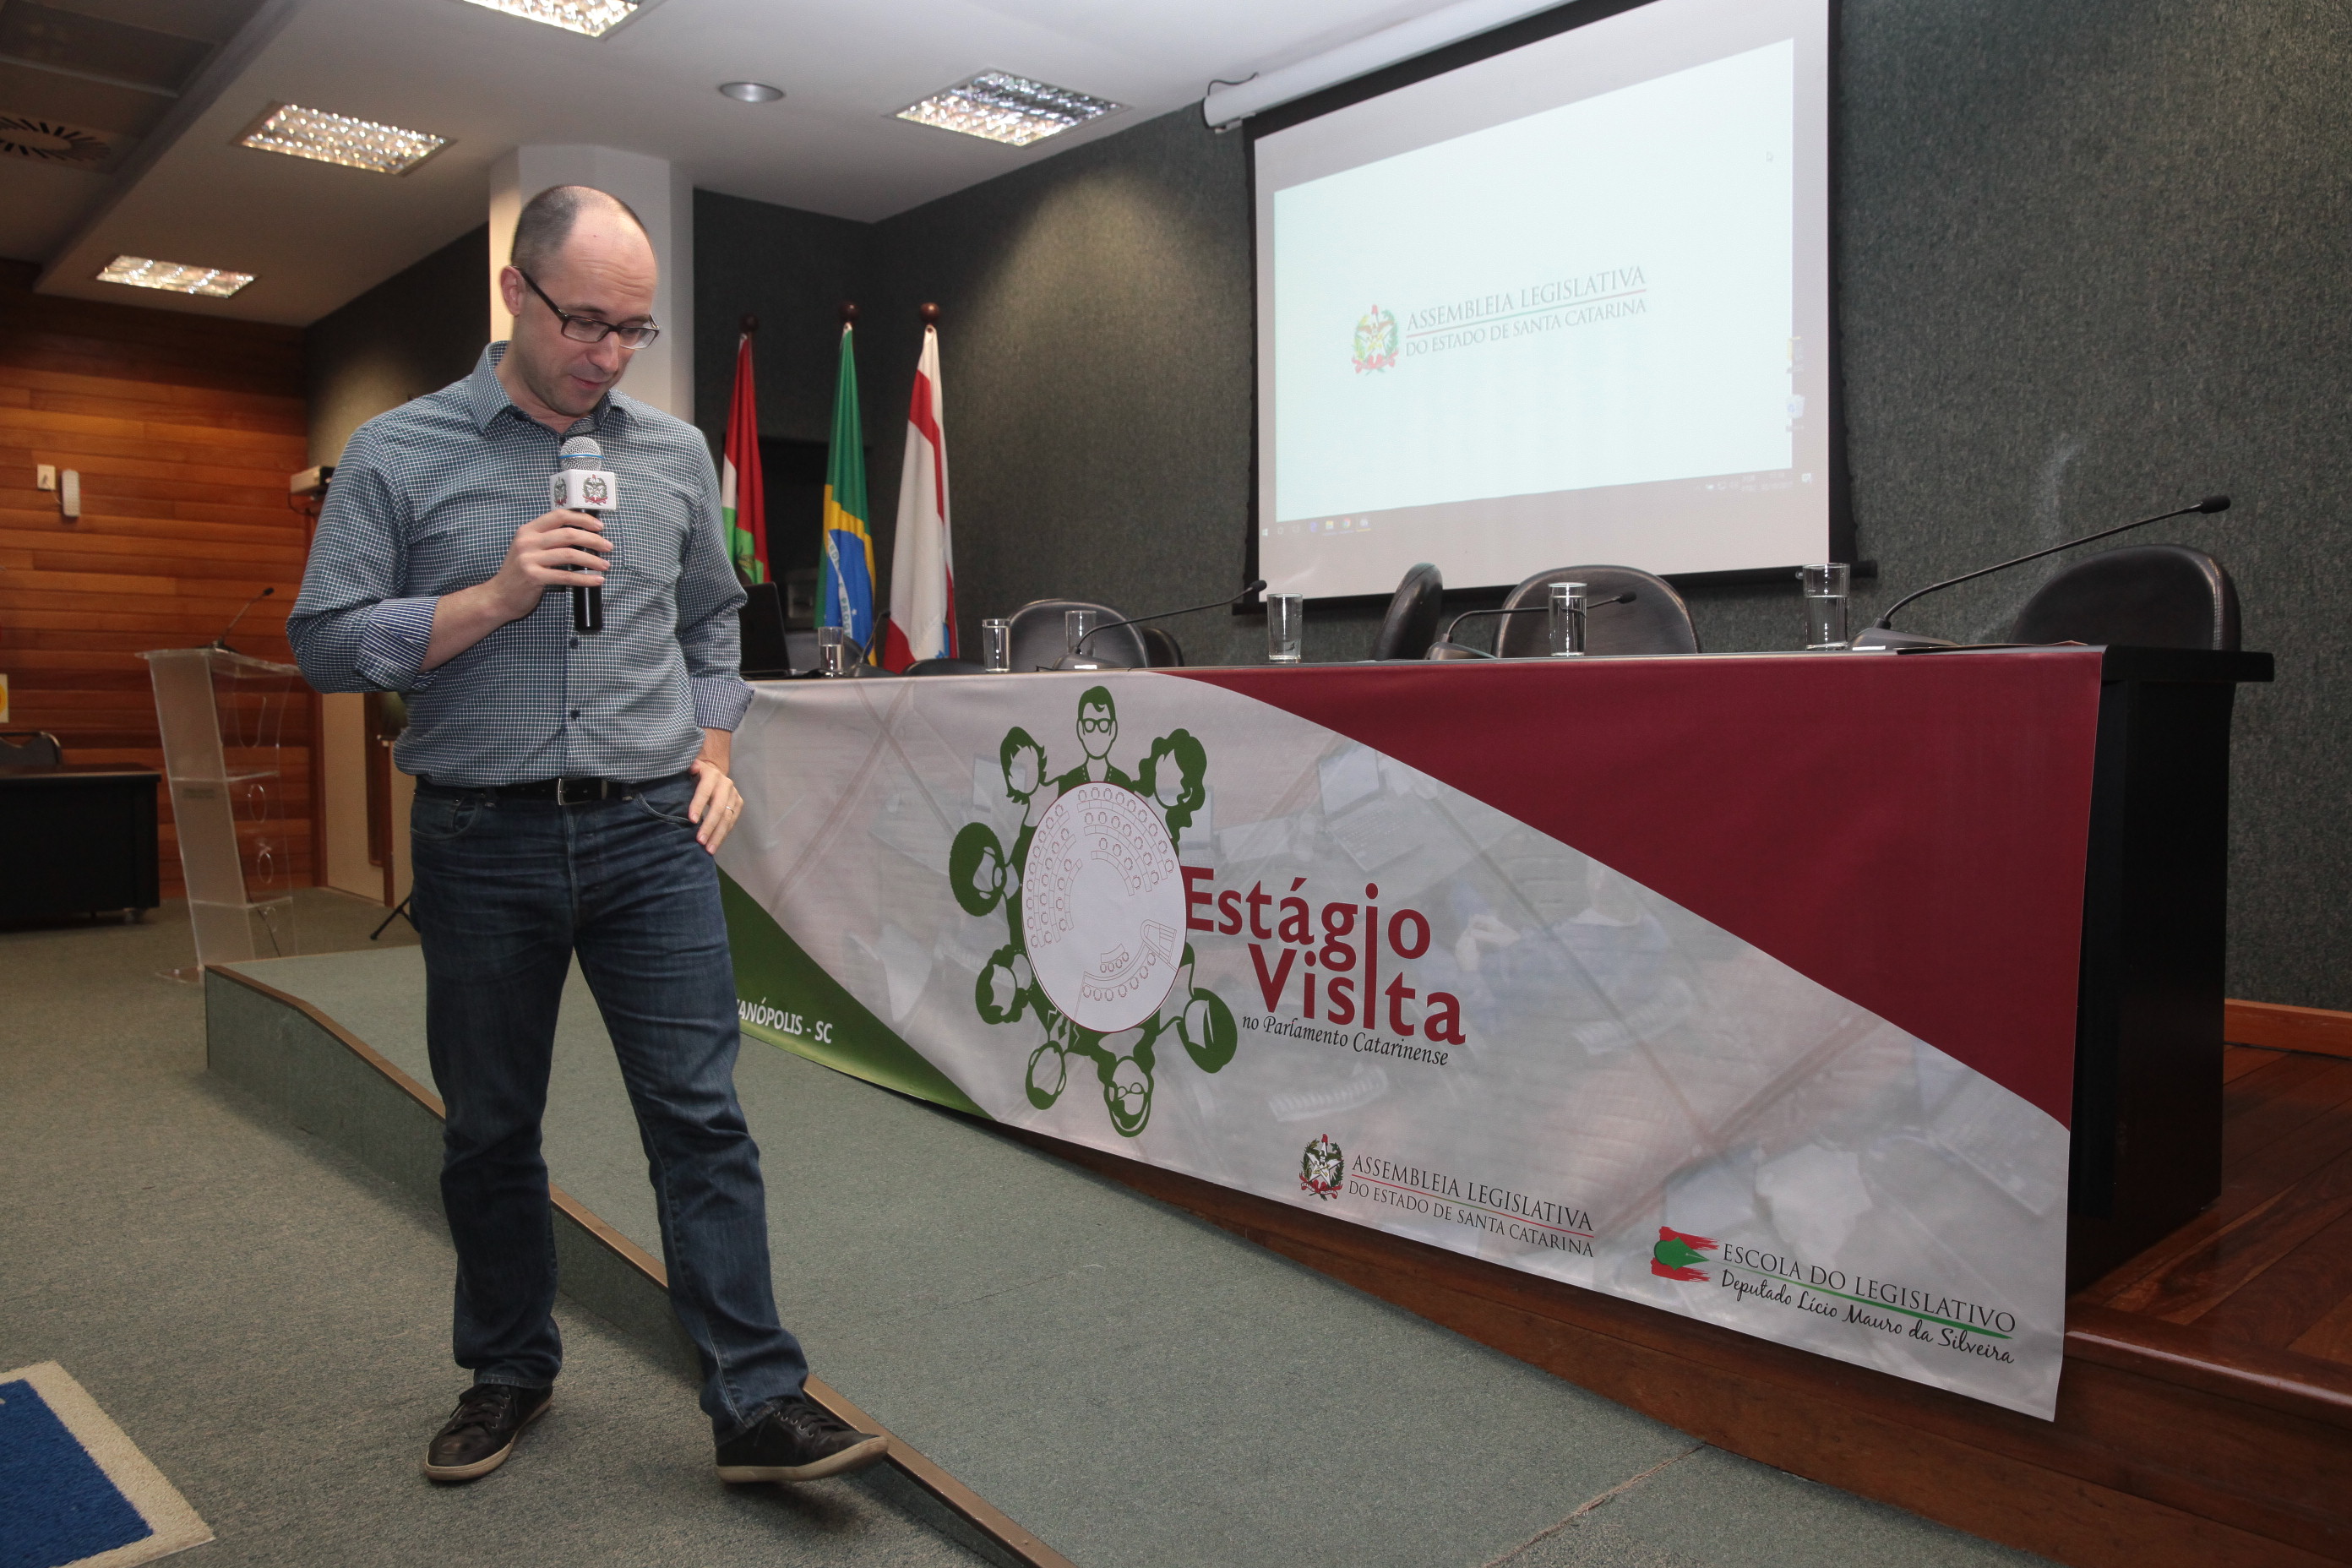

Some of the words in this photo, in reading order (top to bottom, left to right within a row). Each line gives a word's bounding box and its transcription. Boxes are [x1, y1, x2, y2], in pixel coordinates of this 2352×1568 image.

[1406, 340, 1428, 357] DO
[1431, 328, 1486, 352] ESTADO
[1489, 324, 1510, 342] DE
[1512, 313, 1560, 336] SANTA
[1565, 298, 1647, 326] CATARINA
[1407, 293, 1515, 331] ASSEMBLEIA
[1521, 264, 1647, 308] LEGISLATIVA
[1180, 865, 1430, 972] Estágio
[737, 996, 803, 1035] ANÓPOLIS
[814, 1021, 833, 1043] SC
[1242, 1015, 1260, 1030] no
[1263, 1015, 1348, 1047] Parlamento
[1353, 1031, 1449, 1065] Catarinense
[1348, 1180, 1369, 1199] DO
[1374, 1187, 1429, 1214] ESTADO
[1433, 1202, 1451, 1221] DE
[1456, 1209, 1505, 1235] SANTA
[1509, 1223, 1594, 1257] CATARINA
[1352, 1154, 1461, 1198] ASSEMBLEIA
[1467, 1183, 1593, 1232] LEGISLATIVA
[1721, 1269, 1792, 1306] Deputado
[1797, 1291, 1838, 1318] Lício
[1842, 1304, 1903, 1334] Mauro
[1908, 1320, 1933, 1342] da
[1938, 1327, 2015, 1364] Silveira
[1723, 1244, 1802, 1280] ESCOLA
[1810, 1266, 1846, 1290] DO
[1855, 1277, 2017, 1333] LEGISLATIVO
